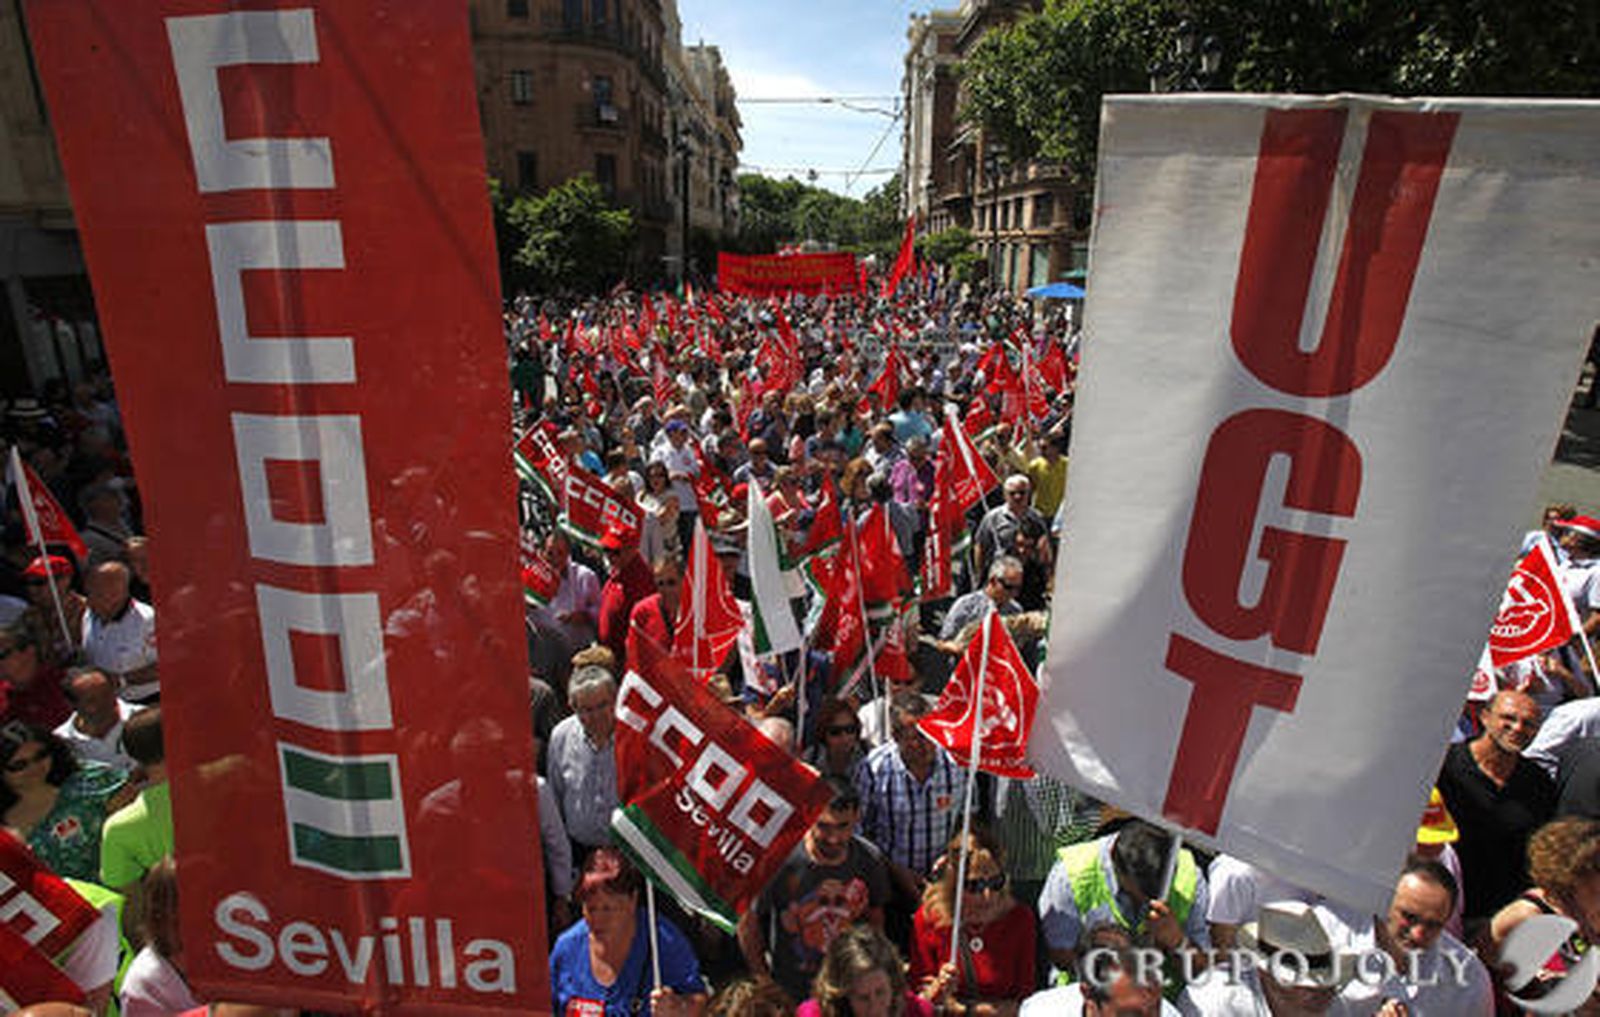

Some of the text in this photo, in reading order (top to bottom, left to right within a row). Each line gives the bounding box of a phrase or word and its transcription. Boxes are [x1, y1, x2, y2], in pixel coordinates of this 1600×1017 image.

[165, 8, 394, 732] CCOO
[565, 475, 637, 529] CCOO
[1163, 108, 1463, 838] UGT
[615, 669, 796, 849] CCOO
[675, 785, 755, 875] Sevilla
[213, 890, 518, 995] Sevilla
